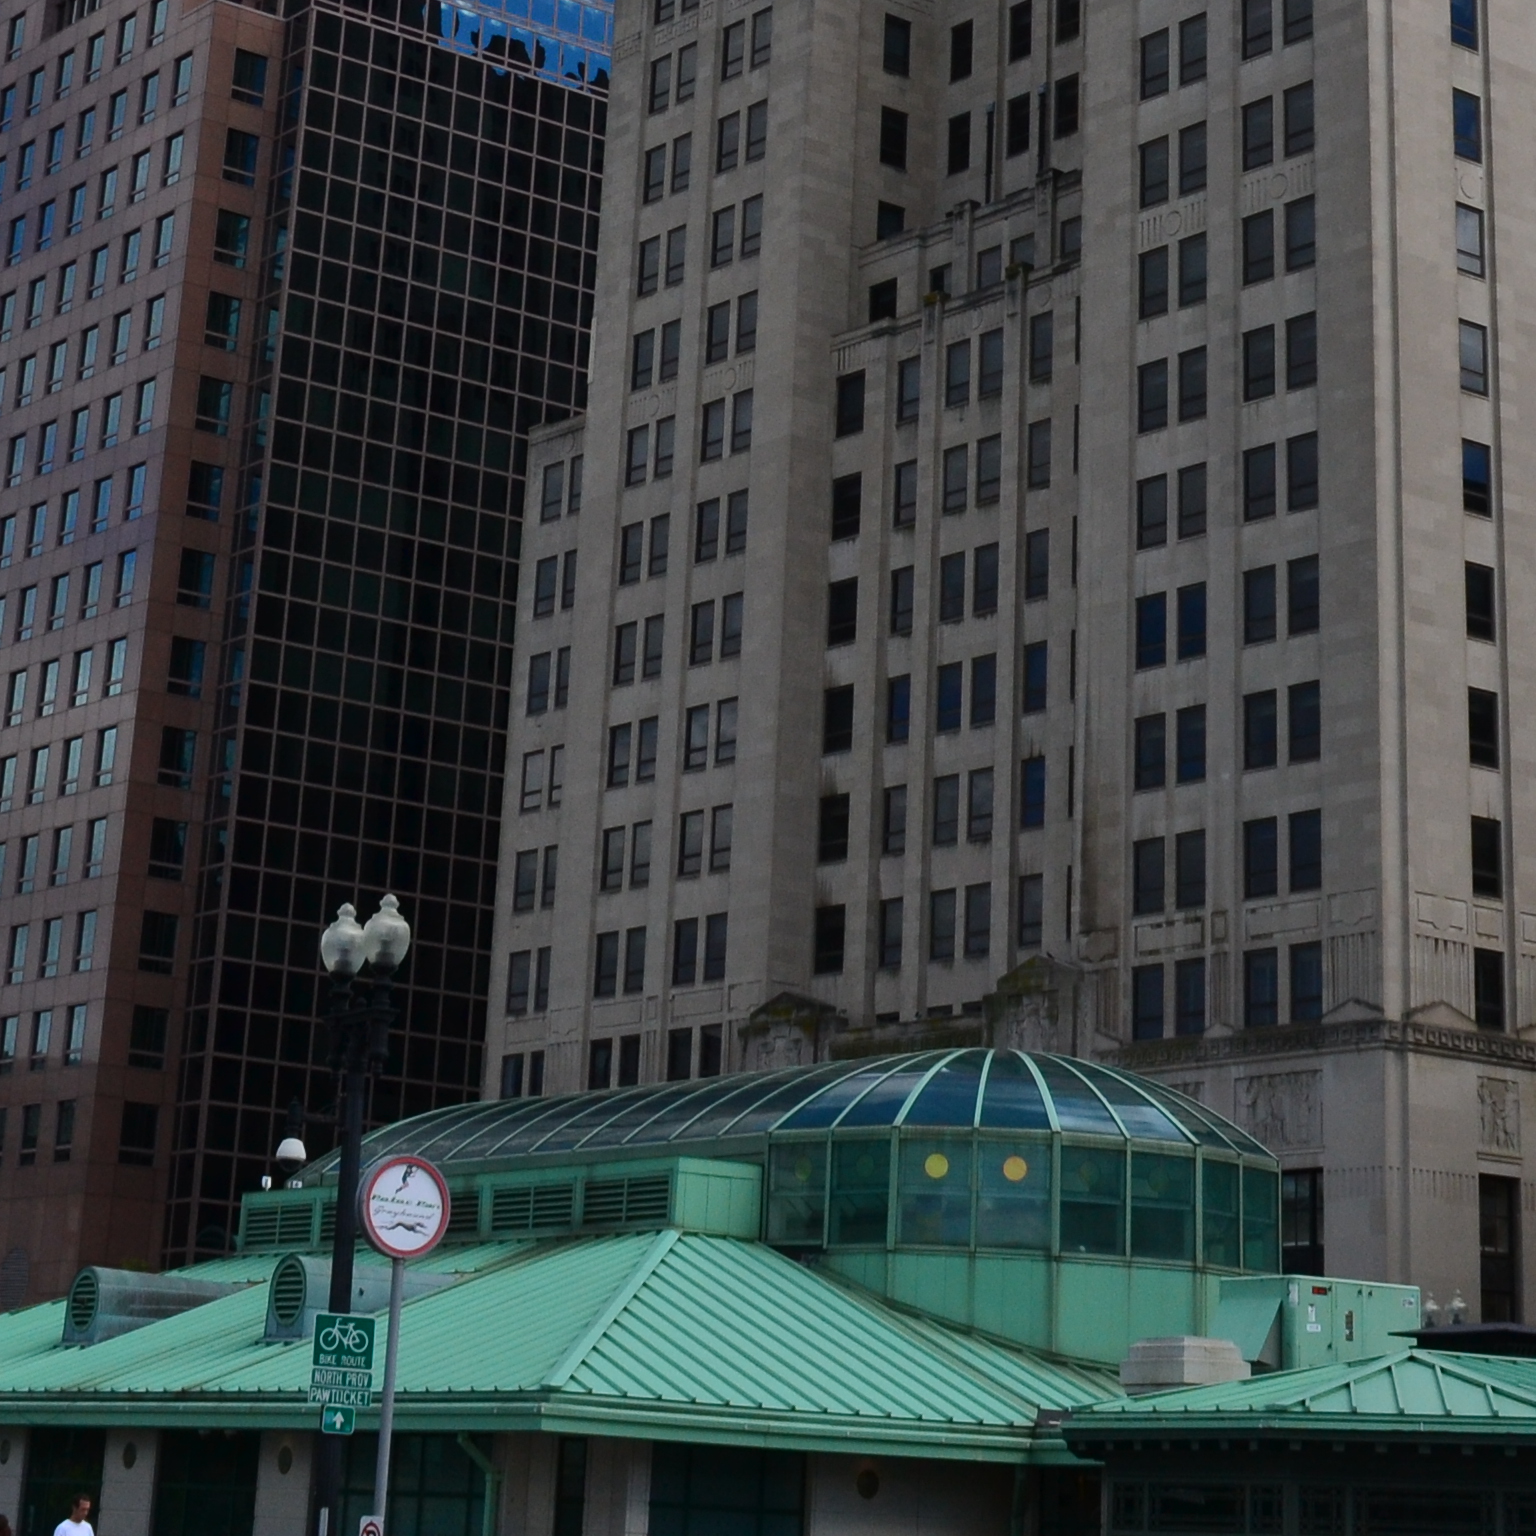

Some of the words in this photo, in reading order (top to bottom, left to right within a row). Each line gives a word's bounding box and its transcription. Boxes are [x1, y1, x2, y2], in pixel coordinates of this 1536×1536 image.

[319, 1353, 337, 1365] BIKE
[341, 1355, 366, 1367] ROUTE
[314, 1369, 343, 1385] NORTH
[346, 1372, 370, 1388] PROV
[311, 1387, 371, 1407] PAWTUCKET
